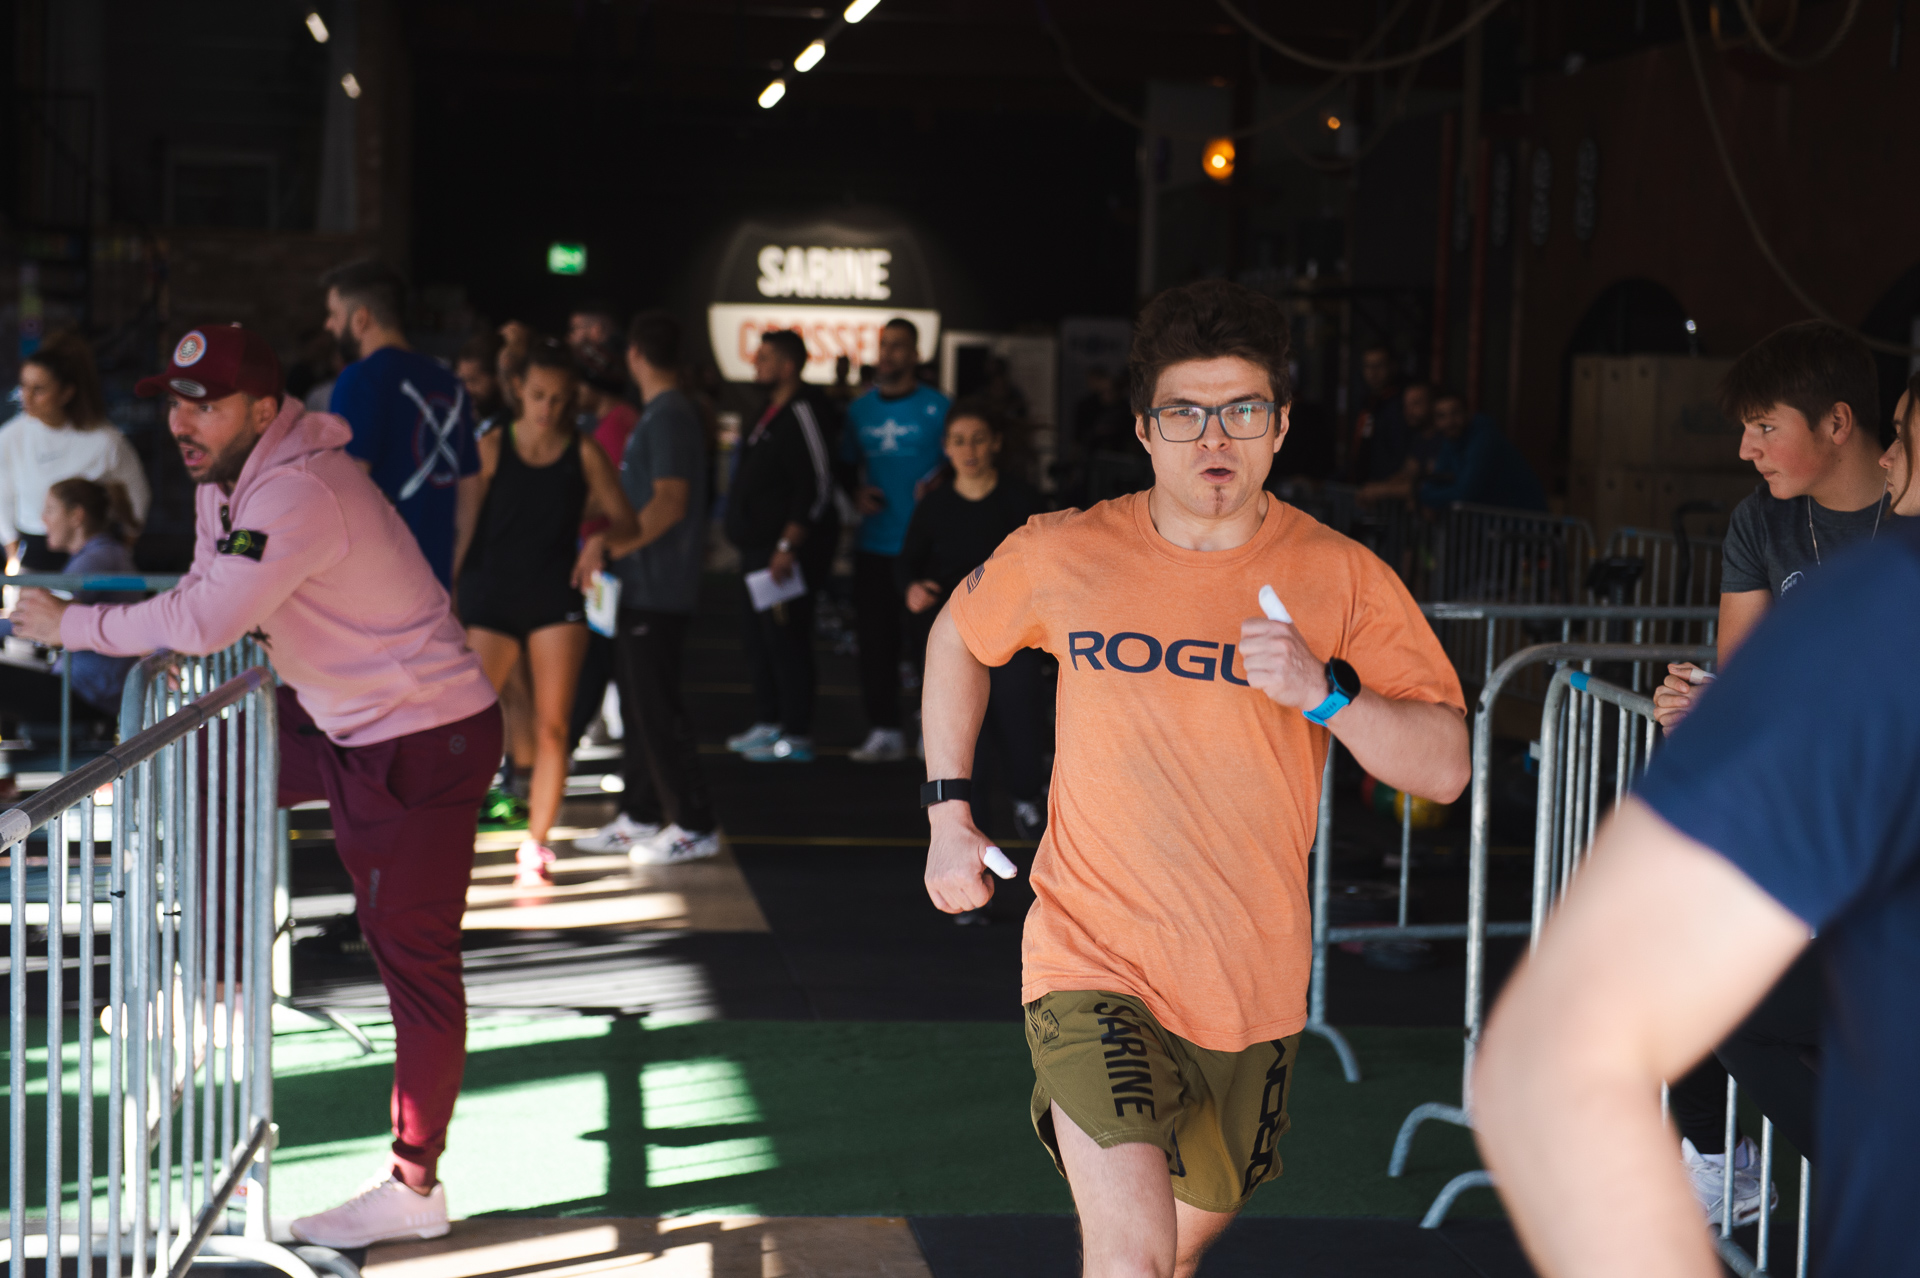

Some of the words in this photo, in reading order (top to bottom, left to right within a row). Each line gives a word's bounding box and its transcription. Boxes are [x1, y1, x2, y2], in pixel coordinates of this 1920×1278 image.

[757, 245, 891, 300] SARINE
[1068, 630, 1250, 687] ROGU
[1093, 1002, 1156, 1120] SARINE
